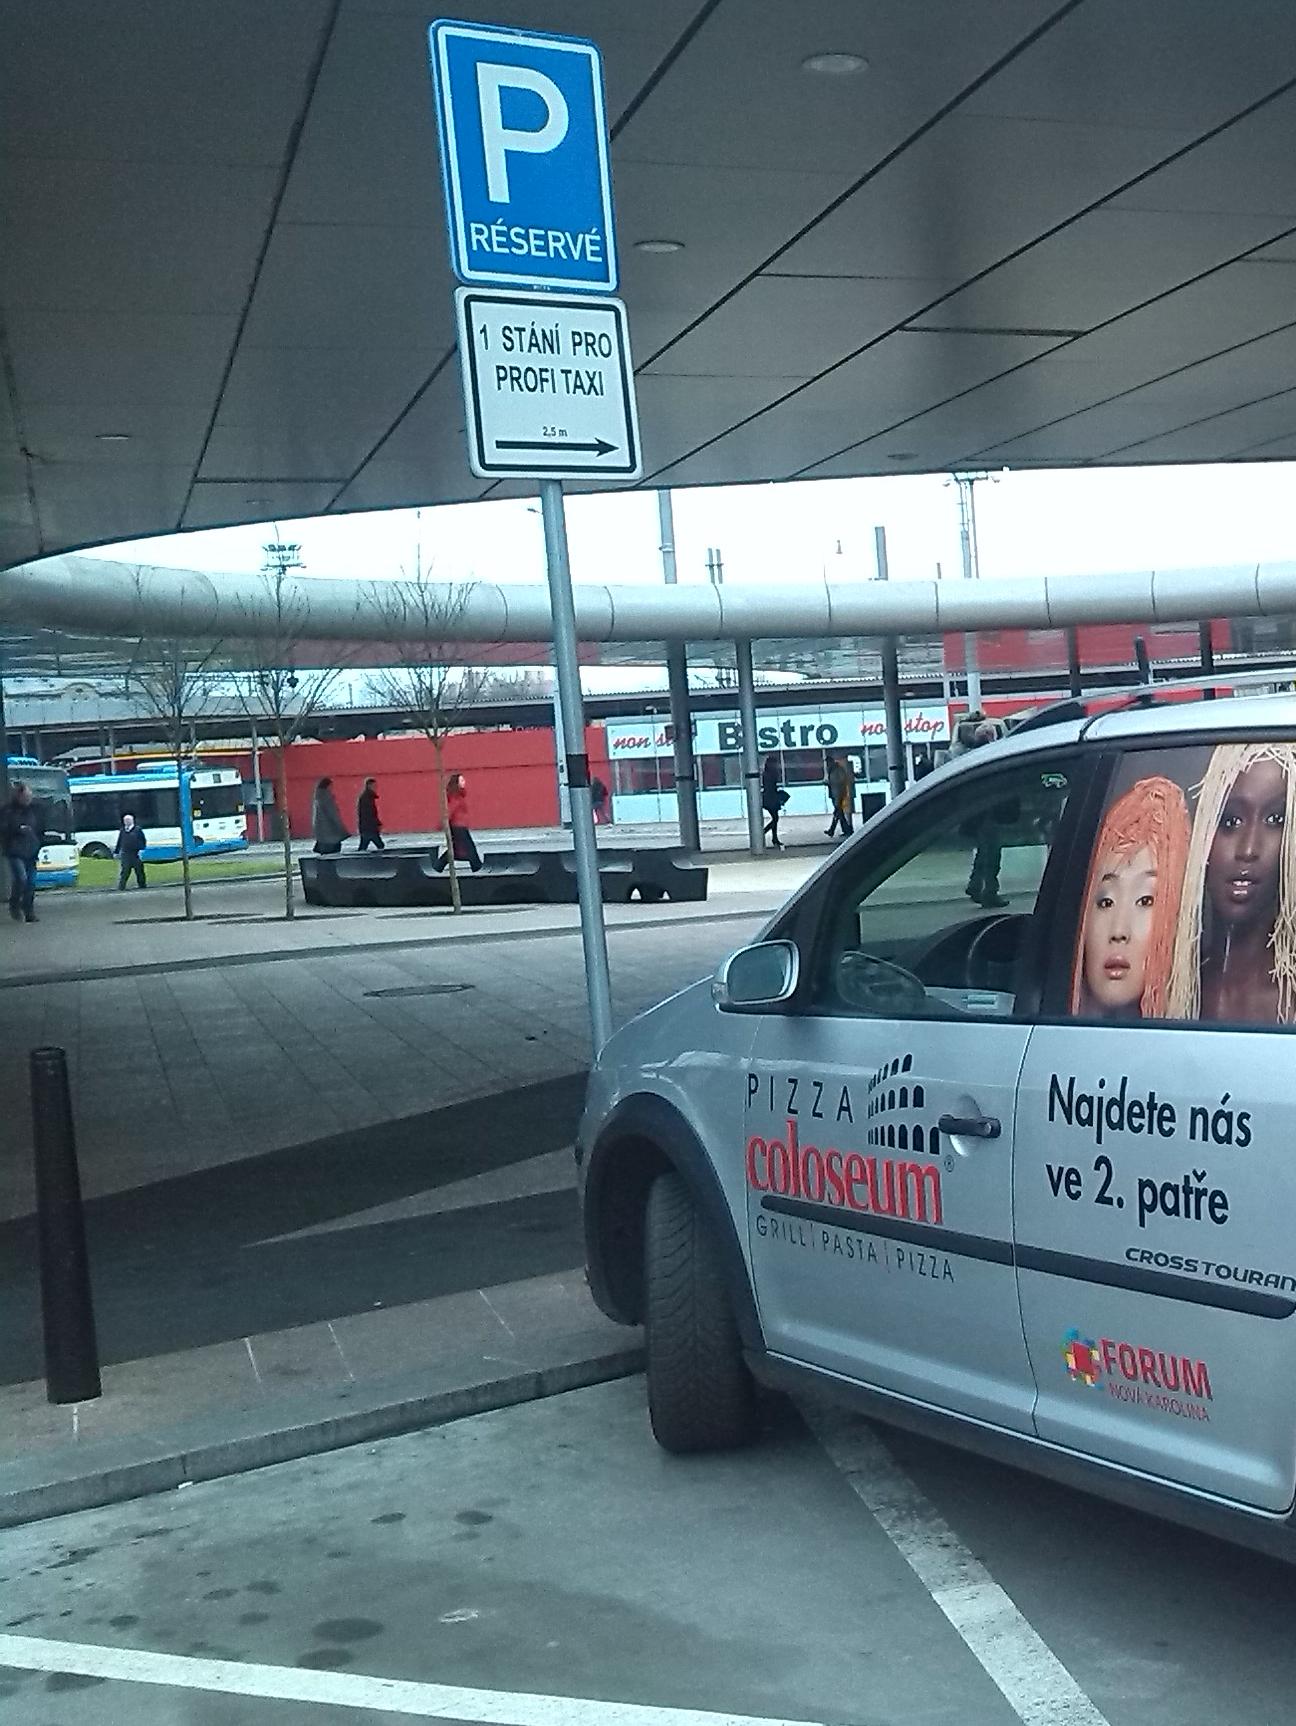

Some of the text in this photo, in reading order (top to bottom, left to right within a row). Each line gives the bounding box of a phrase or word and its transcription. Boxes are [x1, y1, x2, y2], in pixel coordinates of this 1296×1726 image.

[476, 62, 569, 203] P
[471, 218, 603, 262] RÉSERVÉ
[479, 321, 612, 359] 1 STÁNÍ PRO
[496, 365, 604, 397] PROFI TAXI
[718, 717, 839, 751] Bstro
[860, 711, 945, 742] no stop
[747, 1072, 853, 1124] PIZZA
[1048, 1073, 1252, 1148] Najdete nás
[747, 1120, 943, 1226] coloseum
[1046, 1154, 1229, 1228] ve 2. patře
[821, 1229, 878, 1264] PASTA
[895, 1245, 955, 1284] PIZZA
[1100, 1338, 1213, 1401] FORUM
